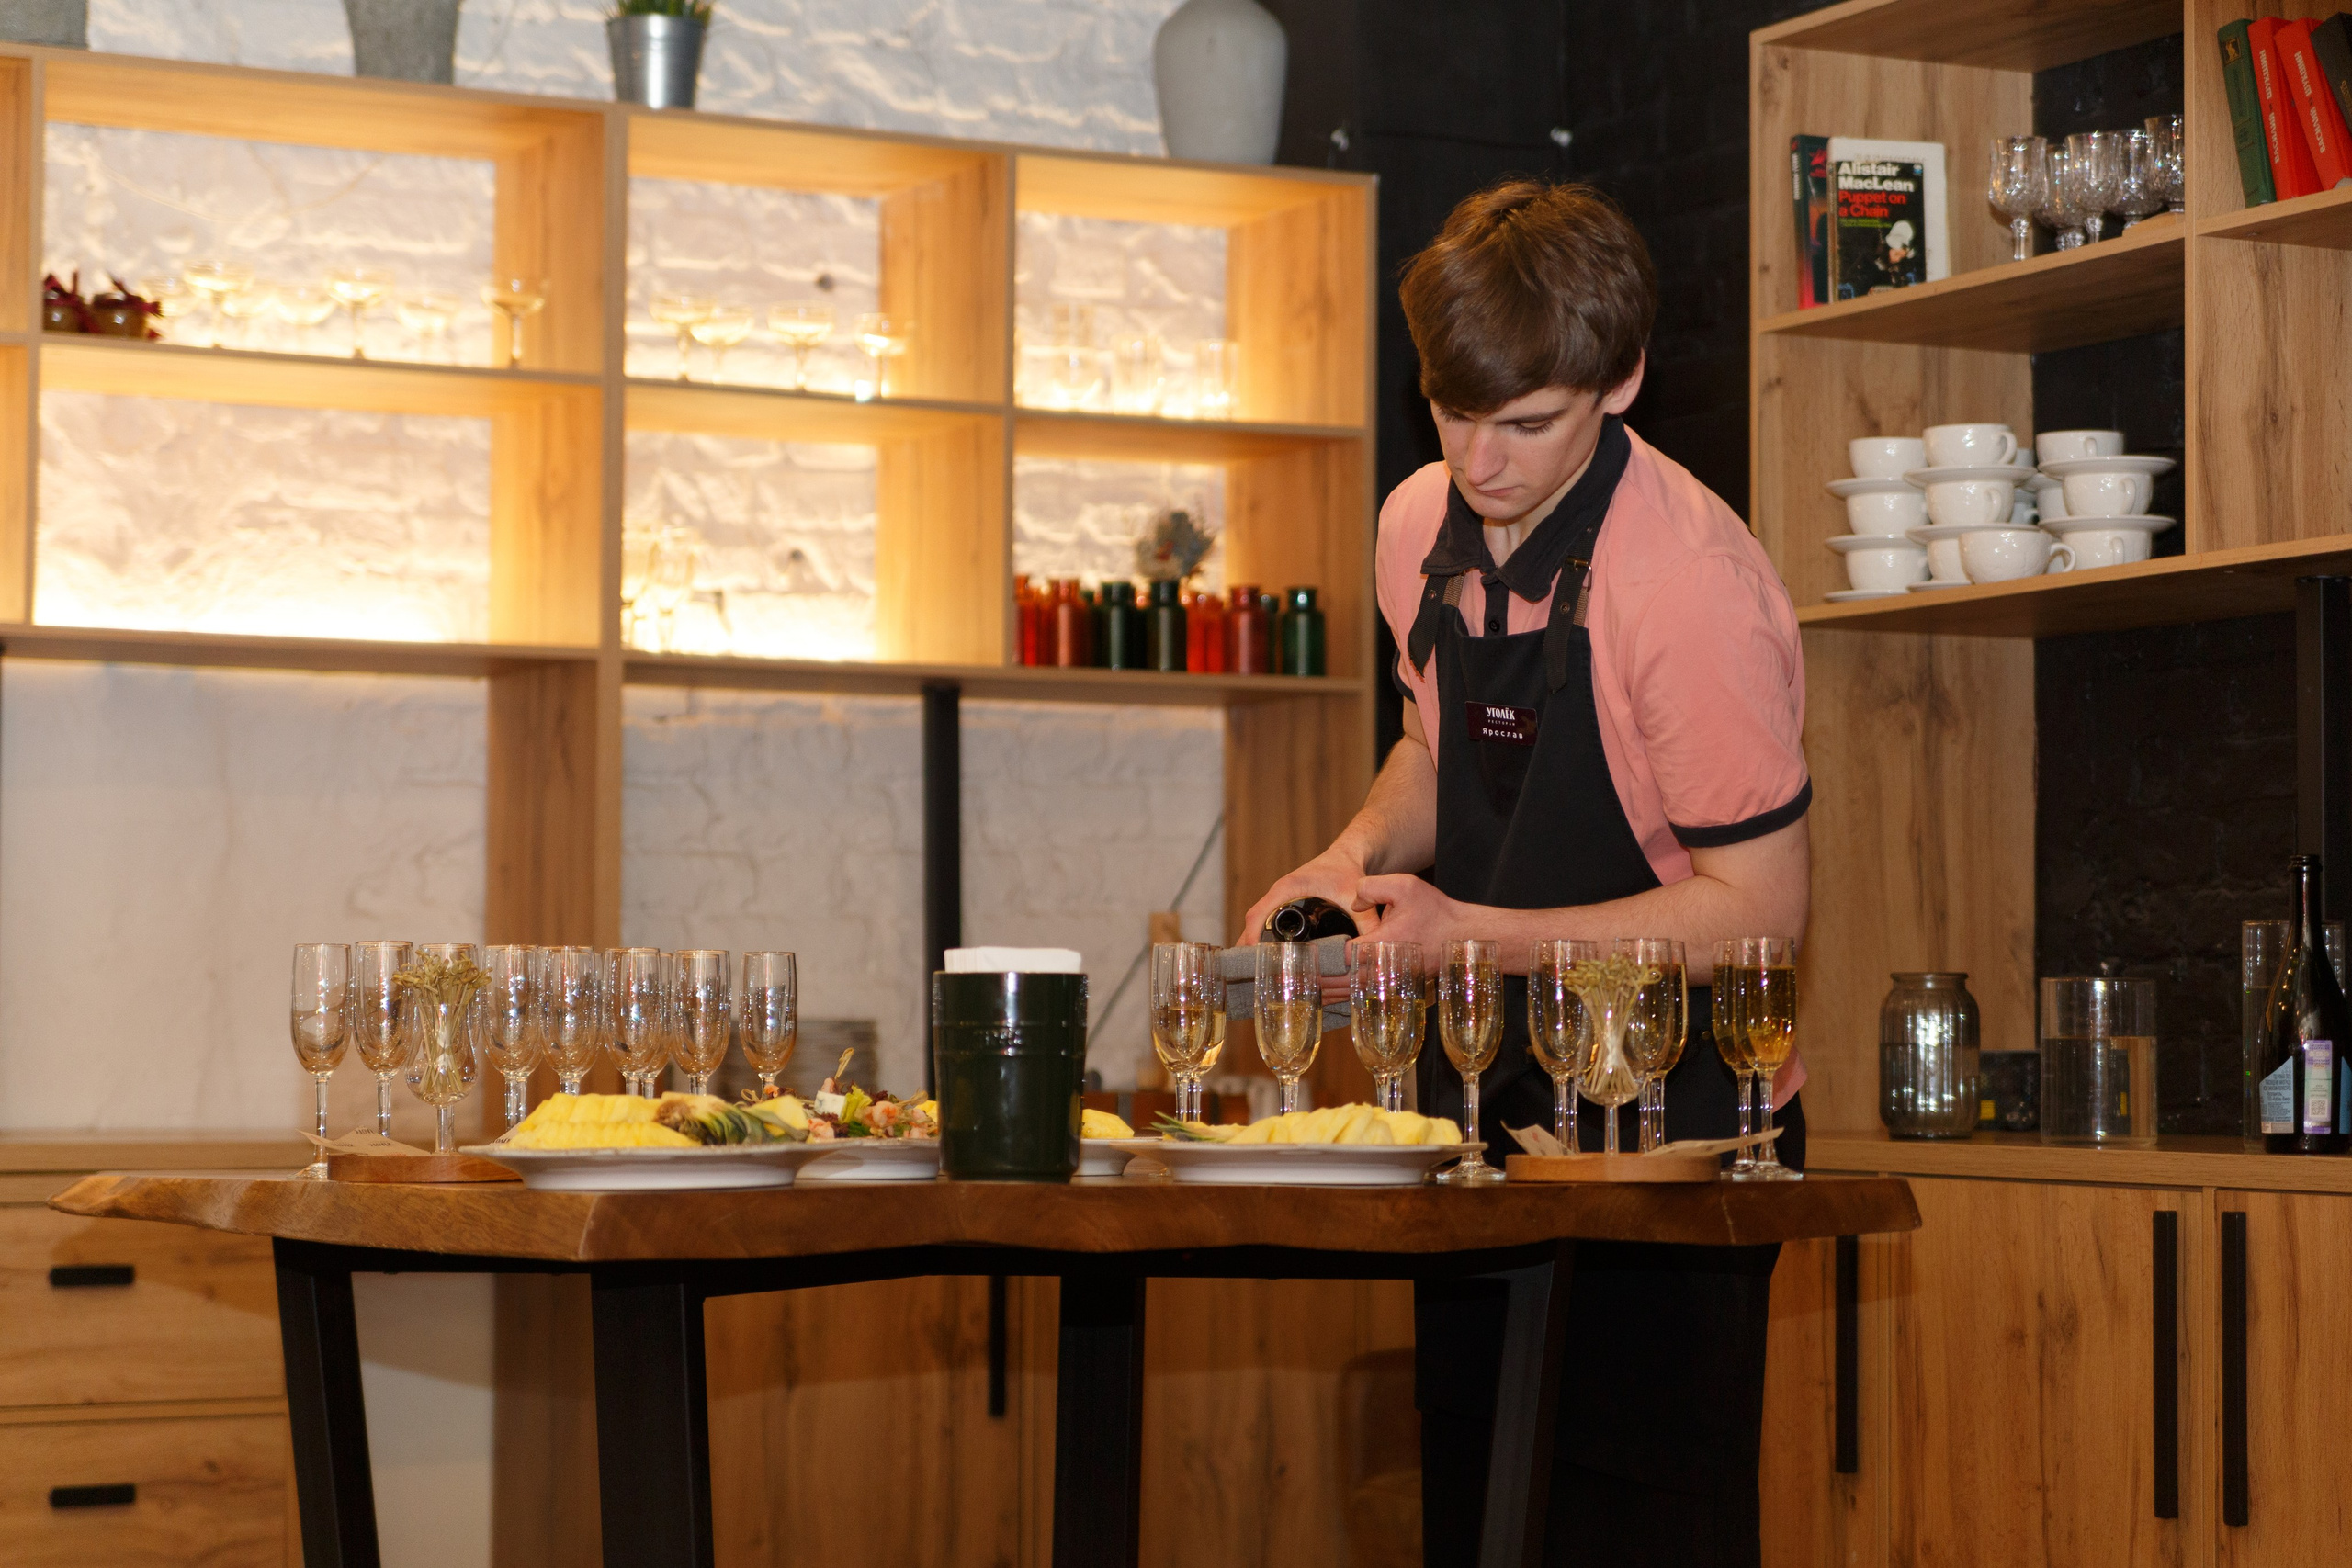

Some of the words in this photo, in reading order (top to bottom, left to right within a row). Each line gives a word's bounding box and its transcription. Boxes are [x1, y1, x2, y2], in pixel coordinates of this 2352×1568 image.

[2259, 49, 2272, 100] ШУКШИН
[2294, 51, 2312, 97] ШУКШИН
[2268, 111, 2279, 164] ВАСИЛИЙ
[2310, 106, 2325, 153] ВАСИЛИЙ
[1838, 161, 1900, 176] Alistair
[1838, 175, 1915, 192] MacLean
[1838, 189, 1886, 205] Puppet
[1888, 194, 1906, 204] on
[1838, 206, 1848, 217] a
[1849, 203, 1889, 218] Chain
[1486, 706, 1515, 720] УГОЛЁК
[1482, 727, 1523, 739] Ярослав
